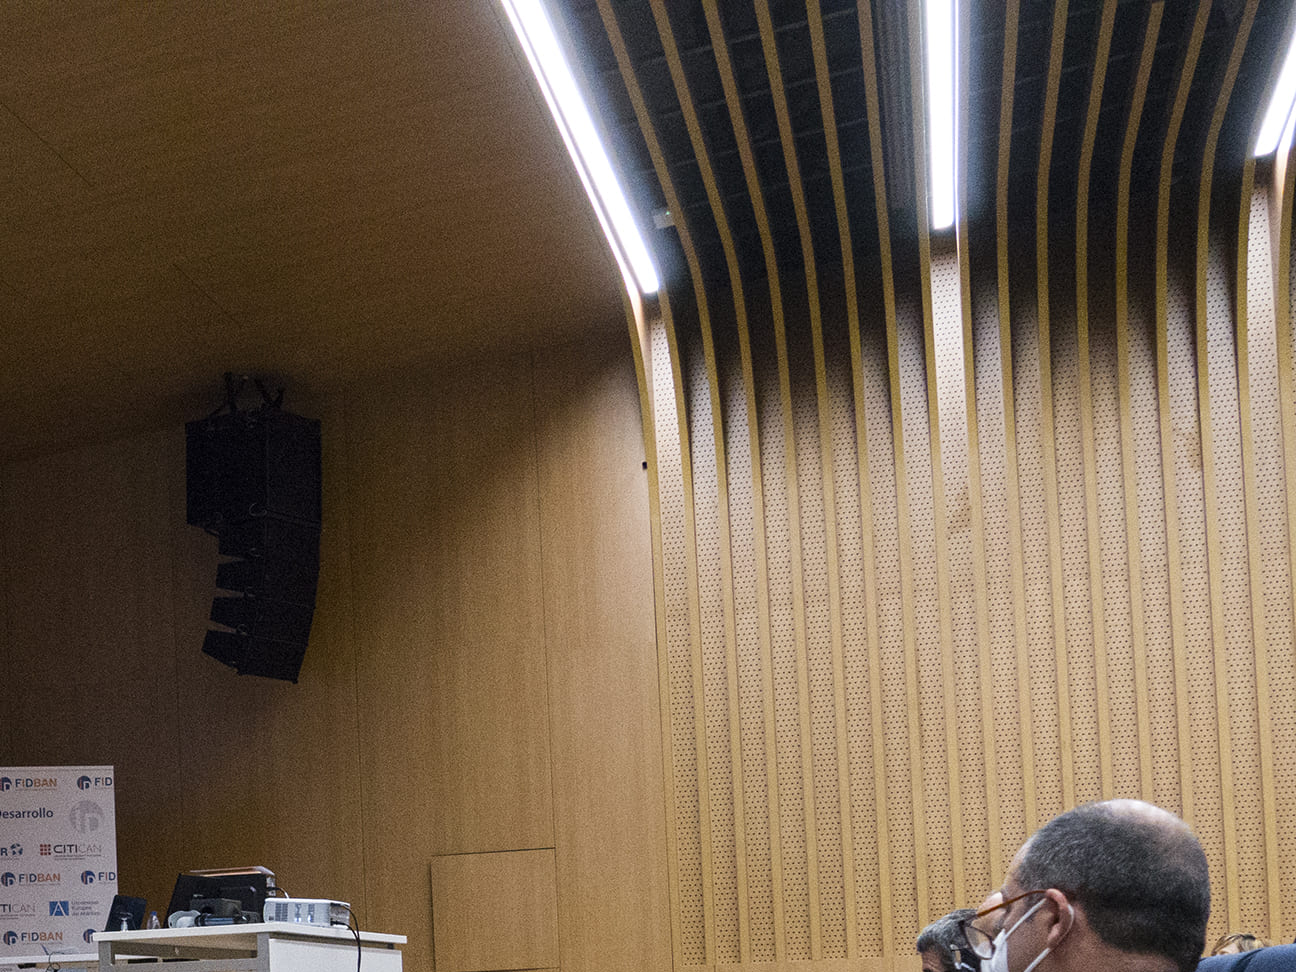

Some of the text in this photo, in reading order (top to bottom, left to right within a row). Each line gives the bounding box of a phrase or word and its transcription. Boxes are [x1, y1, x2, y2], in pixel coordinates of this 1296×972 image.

[15, 778, 58, 788] FIDBAN
[54, 843, 102, 854] CITICAN
[19, 873, 61, 883] FIDBAN
[21, 931, 63, 942] FIDBAN
